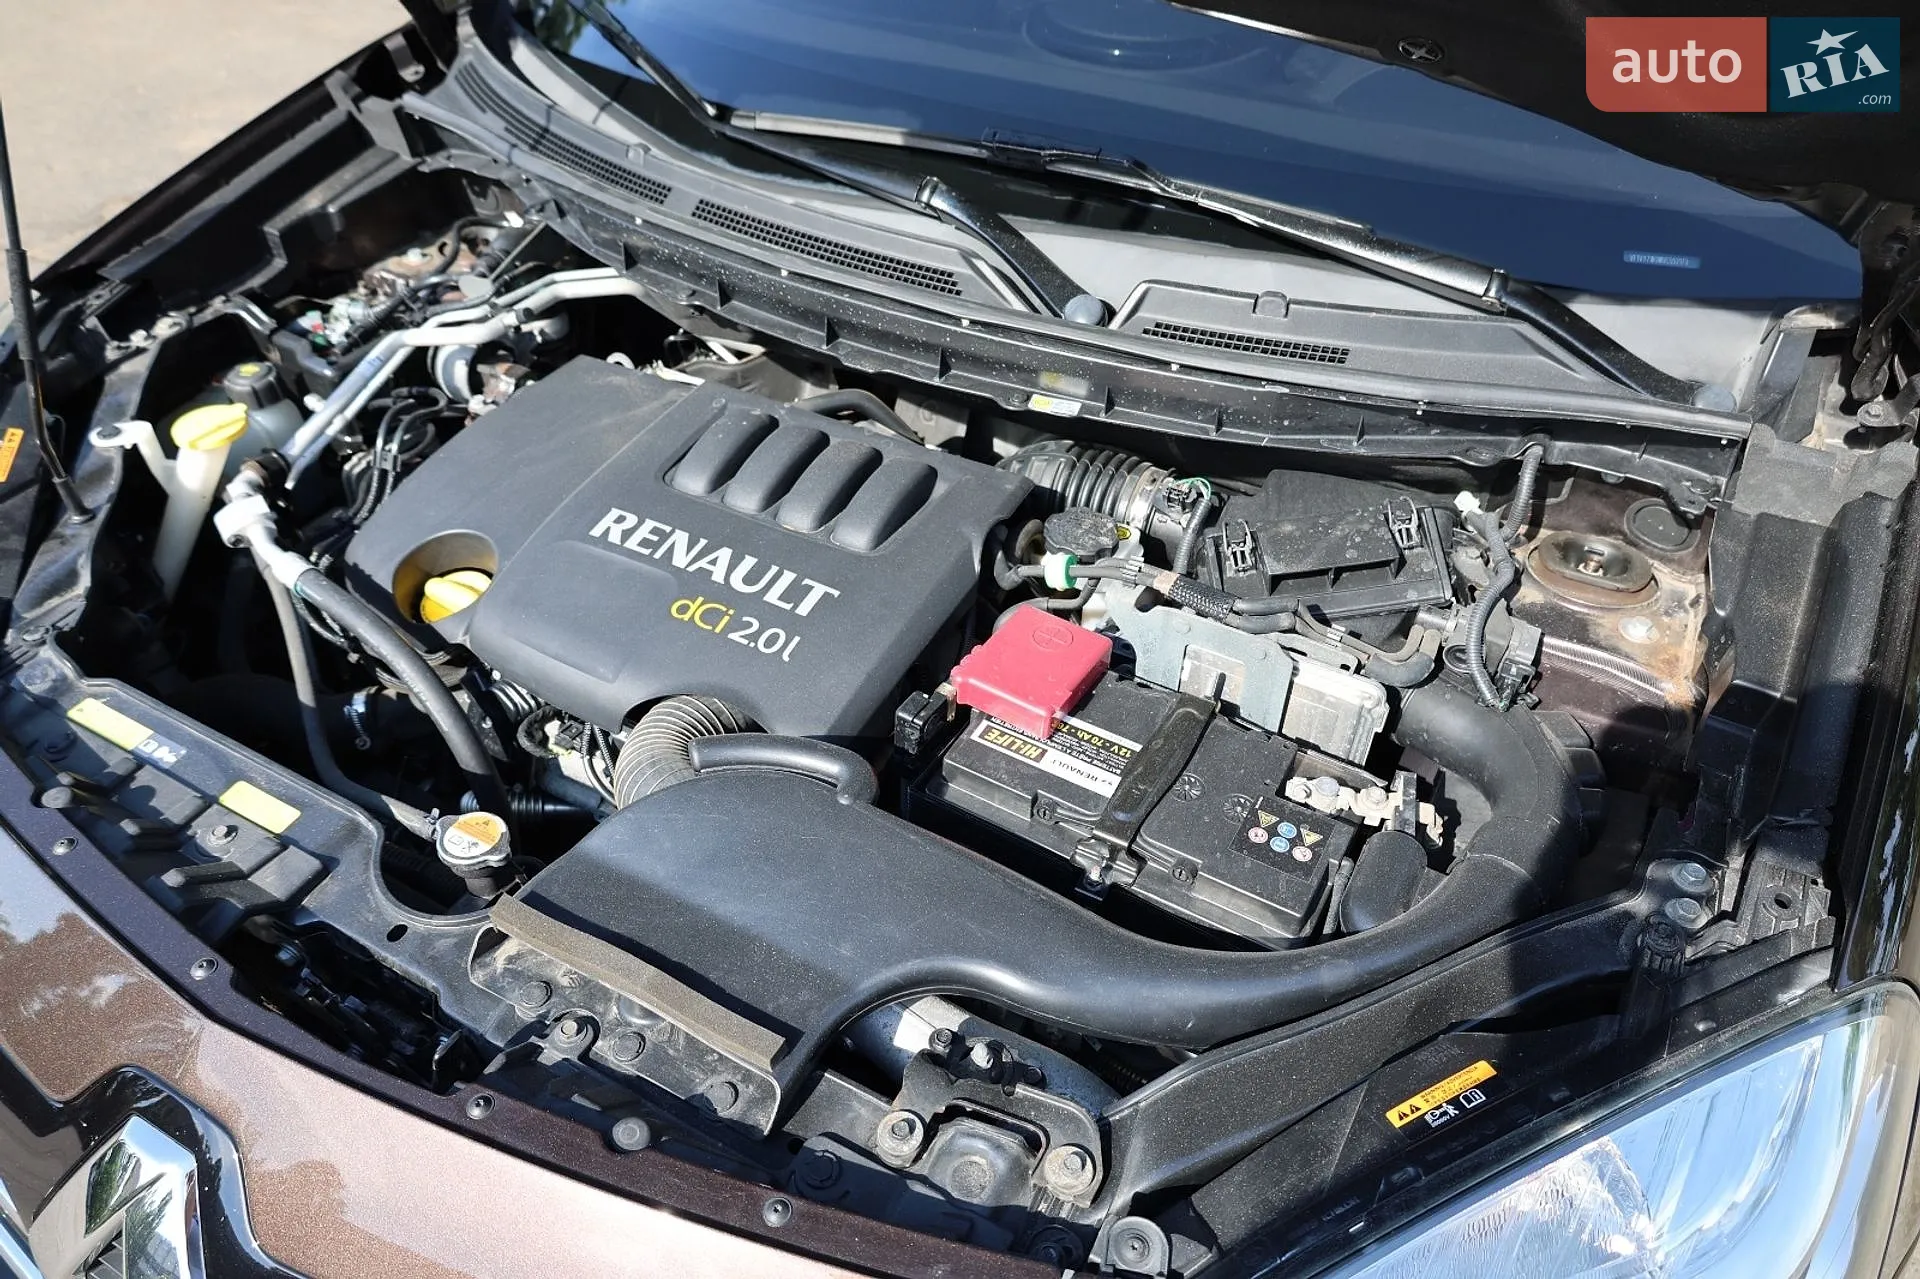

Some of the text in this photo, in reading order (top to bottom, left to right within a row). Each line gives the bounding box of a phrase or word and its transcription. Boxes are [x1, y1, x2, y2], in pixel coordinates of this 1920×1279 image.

[588, 507, 841, 617] RENAULT
[670, 596, 735, 634] dCi
[1052, 759, 1098, 782] RENAULT
